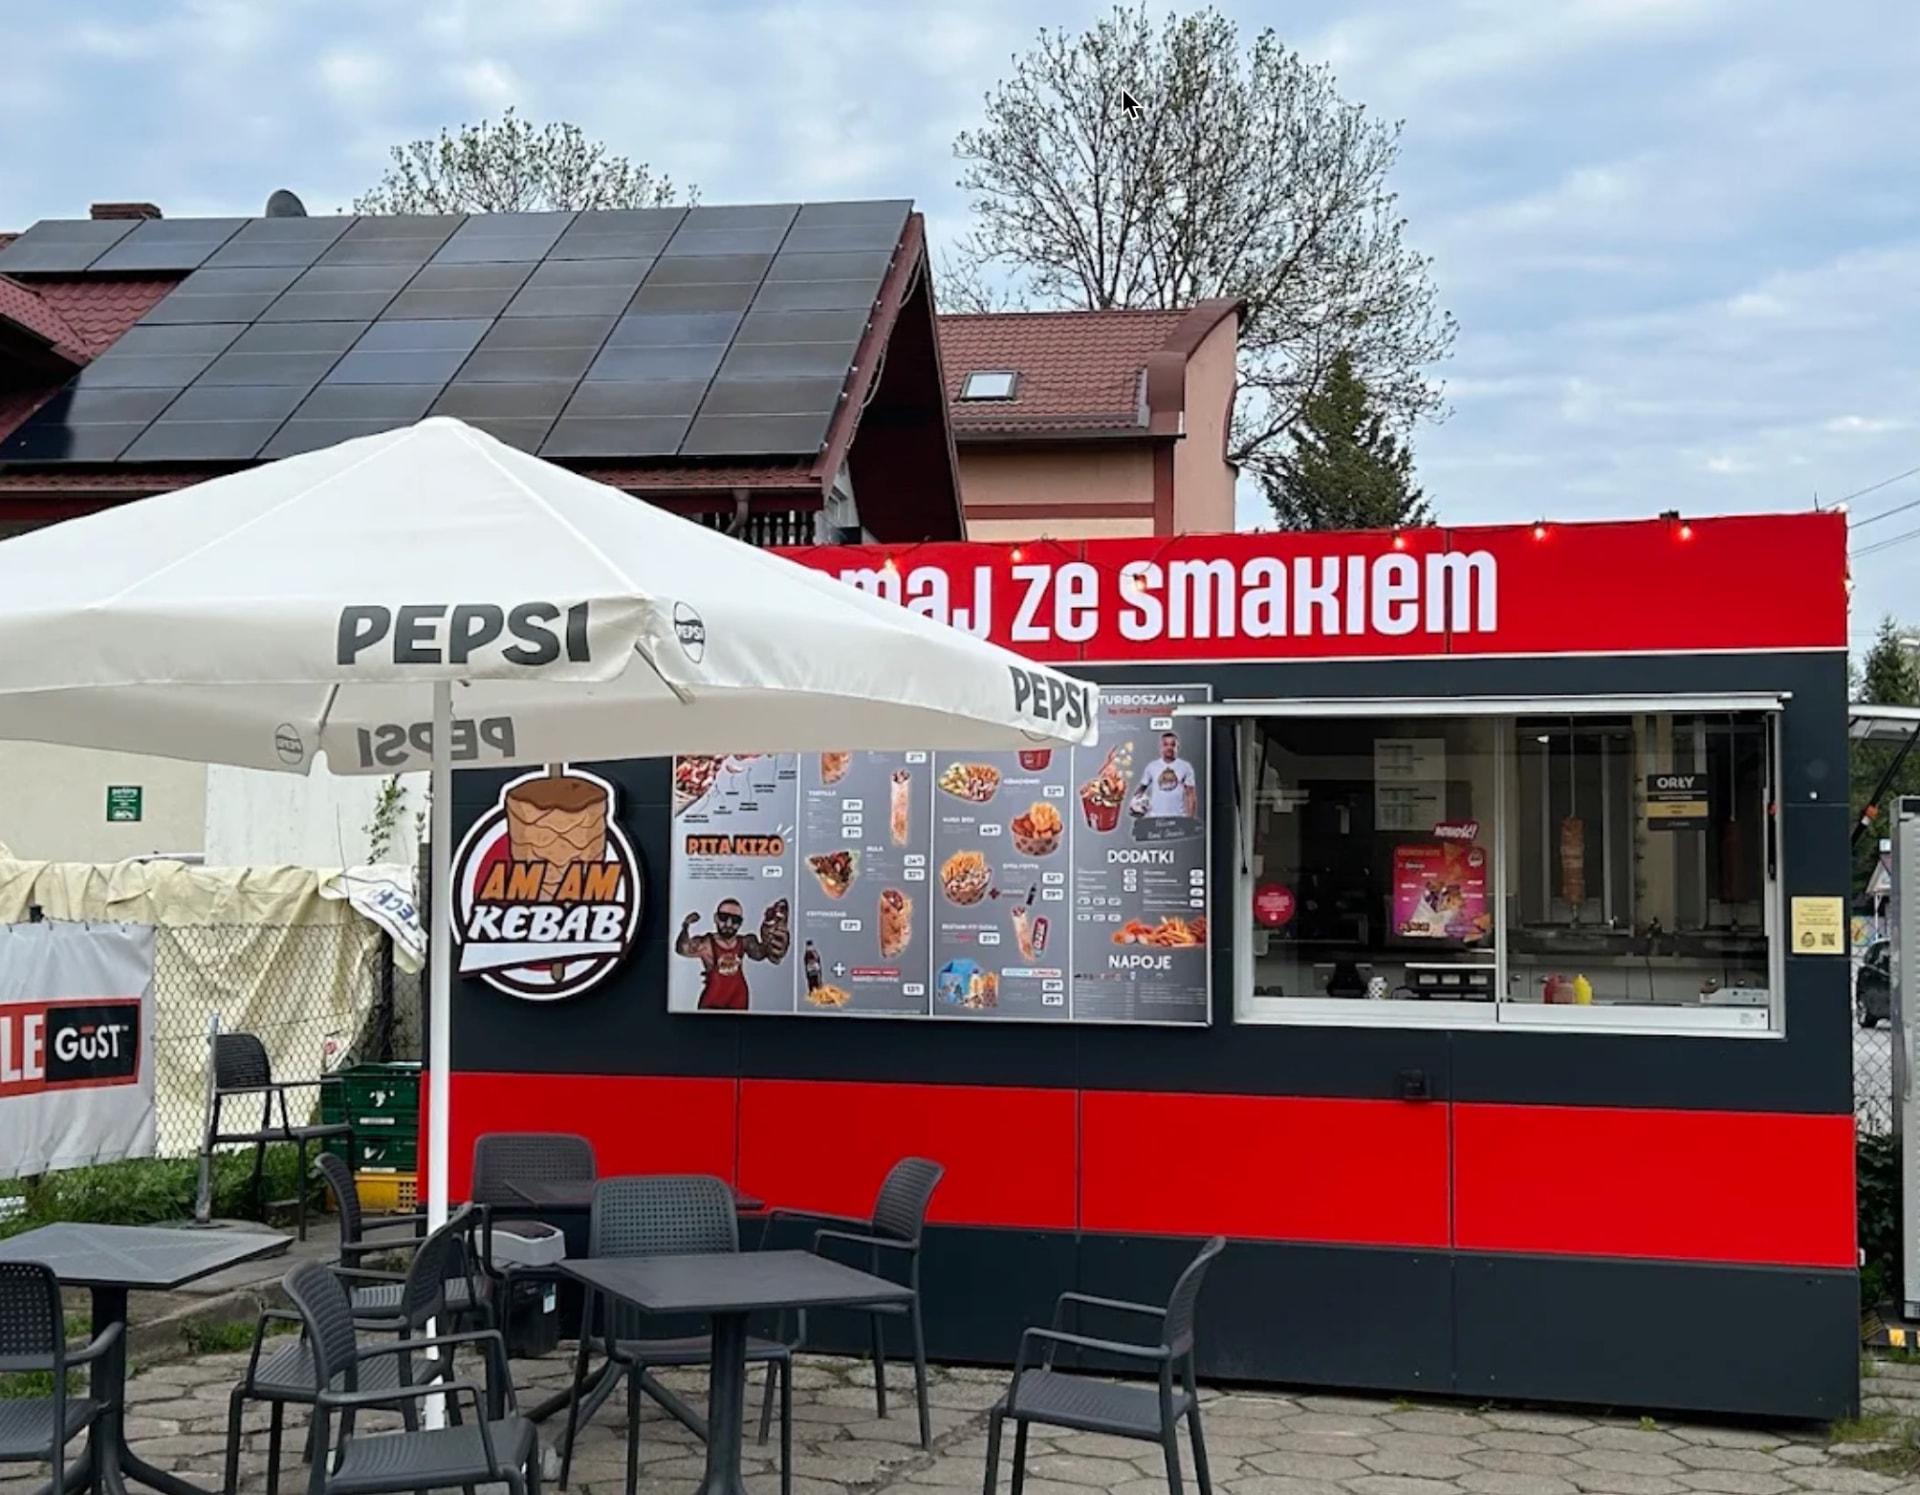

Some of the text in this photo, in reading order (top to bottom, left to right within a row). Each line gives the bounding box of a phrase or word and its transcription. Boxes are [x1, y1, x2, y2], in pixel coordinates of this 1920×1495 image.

[1011, 561, 1099, 642] ze
[1118, 550, 1497, 641] smakiem
[337, 601, 590, 666] PEPSI
[1008, 665, 1090, 729] PEPSI
[1098, 694, 1185, 705] TURBOSZAMA
[1656, 776, 1695, 789] ORŁY
[733, 835, 784, 858] KIZO
[1107, 849, 1175, 864] DODATKI
[479, 861, 622, 900] AM AM
[467, 904, 626, 942] KEBAB
[1108, 954, 1172, 969] NAPOJE
